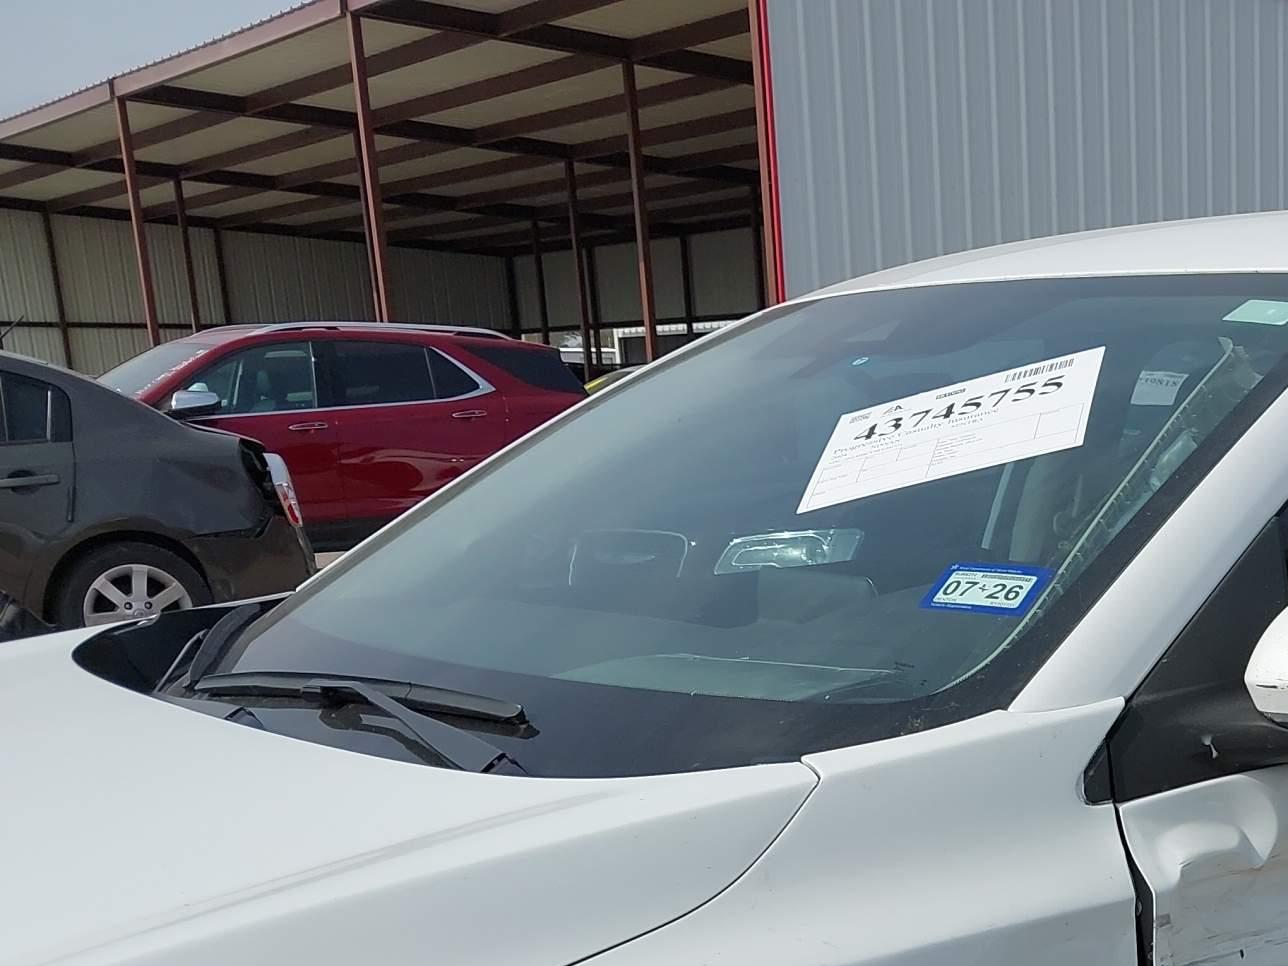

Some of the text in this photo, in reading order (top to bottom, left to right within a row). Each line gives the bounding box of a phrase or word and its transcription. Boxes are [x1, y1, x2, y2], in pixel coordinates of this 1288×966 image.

[853, 375, 1065, 441] 43745755
[942, 580, 1024, 602] 07 26
